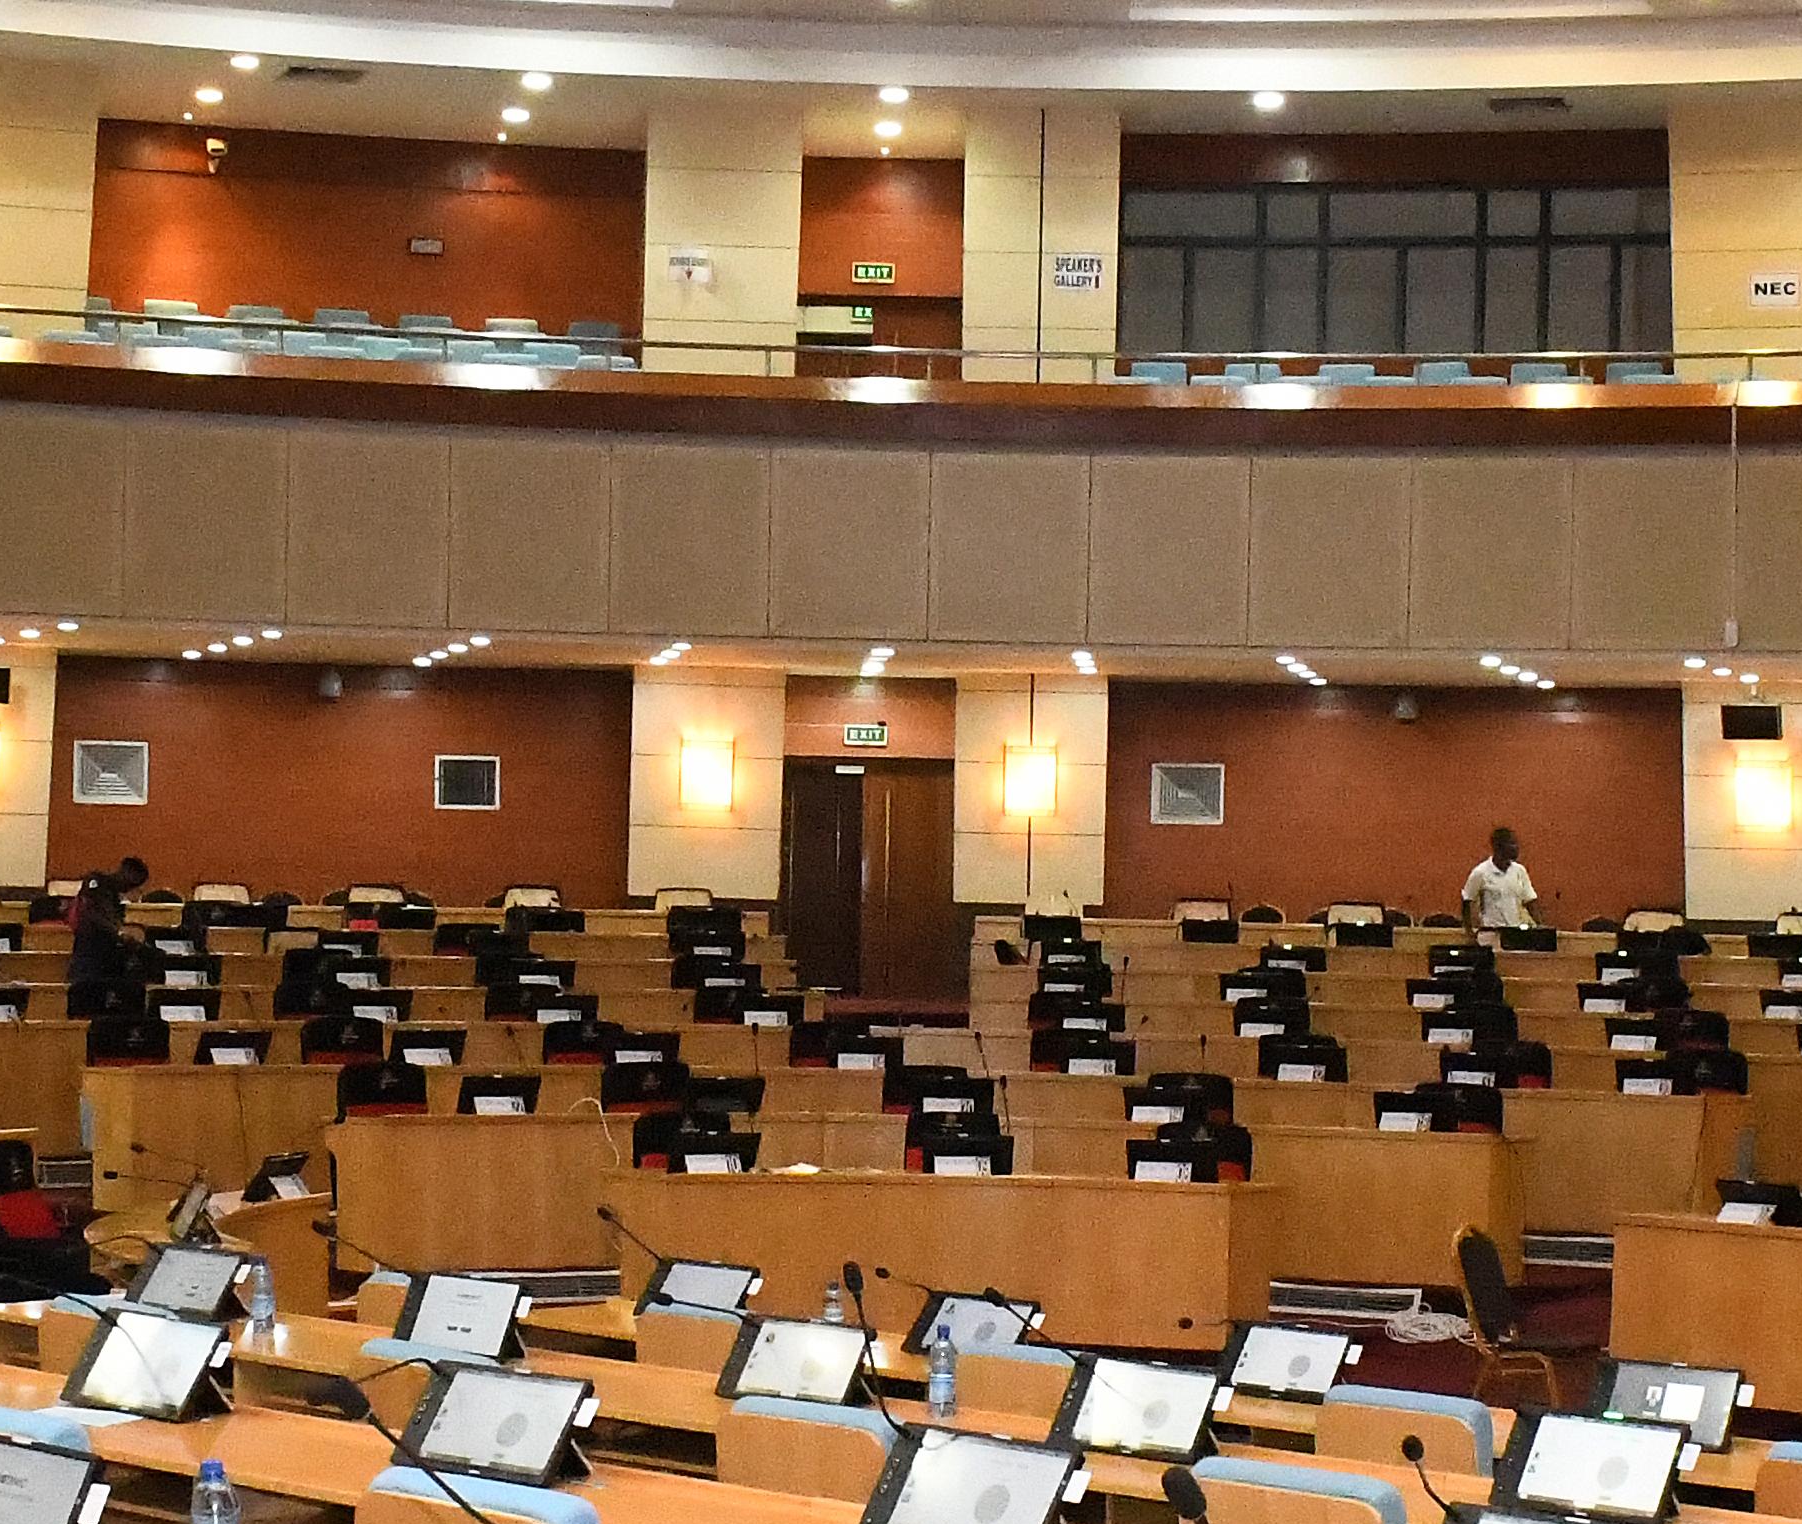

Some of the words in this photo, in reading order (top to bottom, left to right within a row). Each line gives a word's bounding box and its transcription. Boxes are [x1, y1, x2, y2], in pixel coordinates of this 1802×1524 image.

[857, 266, 890, 278] EXIT
[1754, 282, 1796, 295] NEC
[849, 729, 882, 740] EXIT
